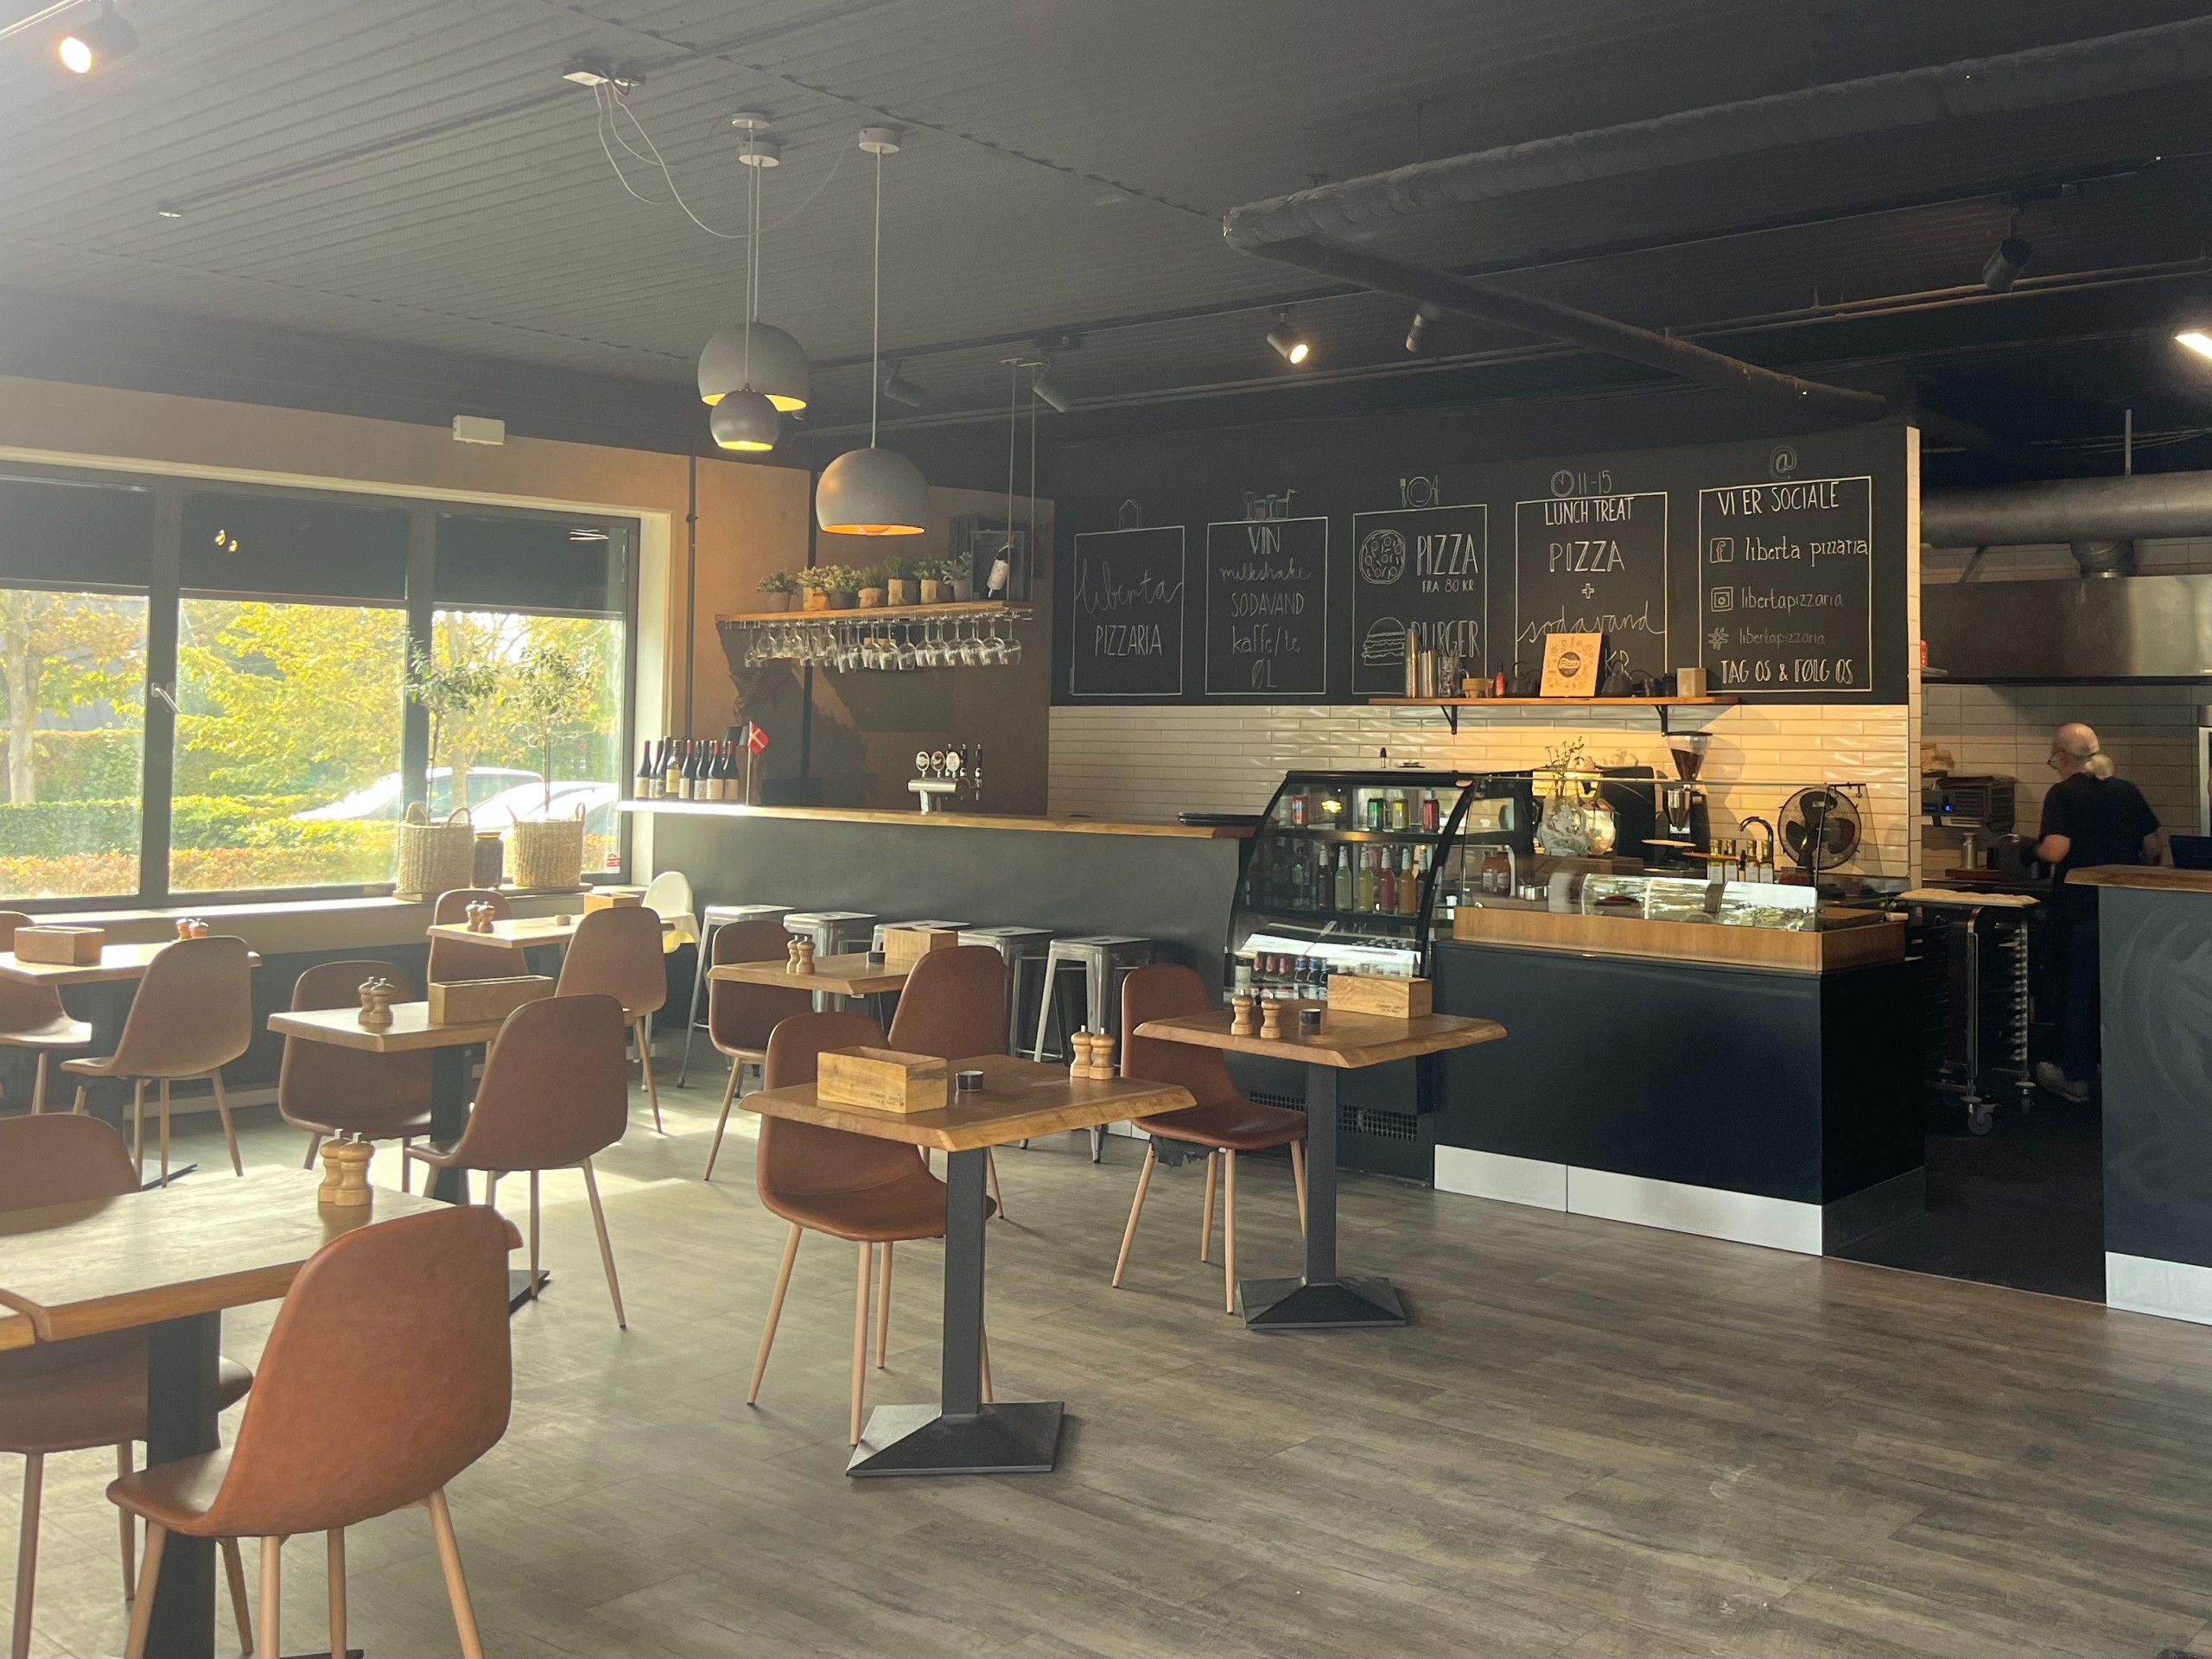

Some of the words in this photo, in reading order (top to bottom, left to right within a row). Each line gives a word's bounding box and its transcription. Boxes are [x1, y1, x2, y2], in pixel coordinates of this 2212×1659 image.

[1544, 499, 1589, 526] LUNCH
[1592, 496, 1635, 522] TREAT
[1717, 491, 1735, 516] VI
[1742, 487, 1763, 516] ER
[1770, 480, 1840, 512] SOCIALE
[1247, 526, 1281, 555] VIN
[1416, 533, 1479, 576] PIZZA
[1548, 539, 1626, 573] PIZZA
[1745, 535, 1802, 561] liberta
[1808, 539, 1869, 568] pizzaria
[1218, 557, 1313, 582] milkshake
[1421, 579, 1440, 594] FRA
[1444, 578, 1459, 594] 80
[1462, 579, 1475, 593] KR
[1230, 592, 1305, 618] SODAVAND
[1095, 623, 1162, 656] PIZZARIA
[1250, 657, 1279, 690] ØL
[1720, 659, 1749, 684] TAG
[1754, 659, 1771, 683] OS
[1794, 658, 1830, 683] FØLG
[1834, 658, 1853, 684] OS
